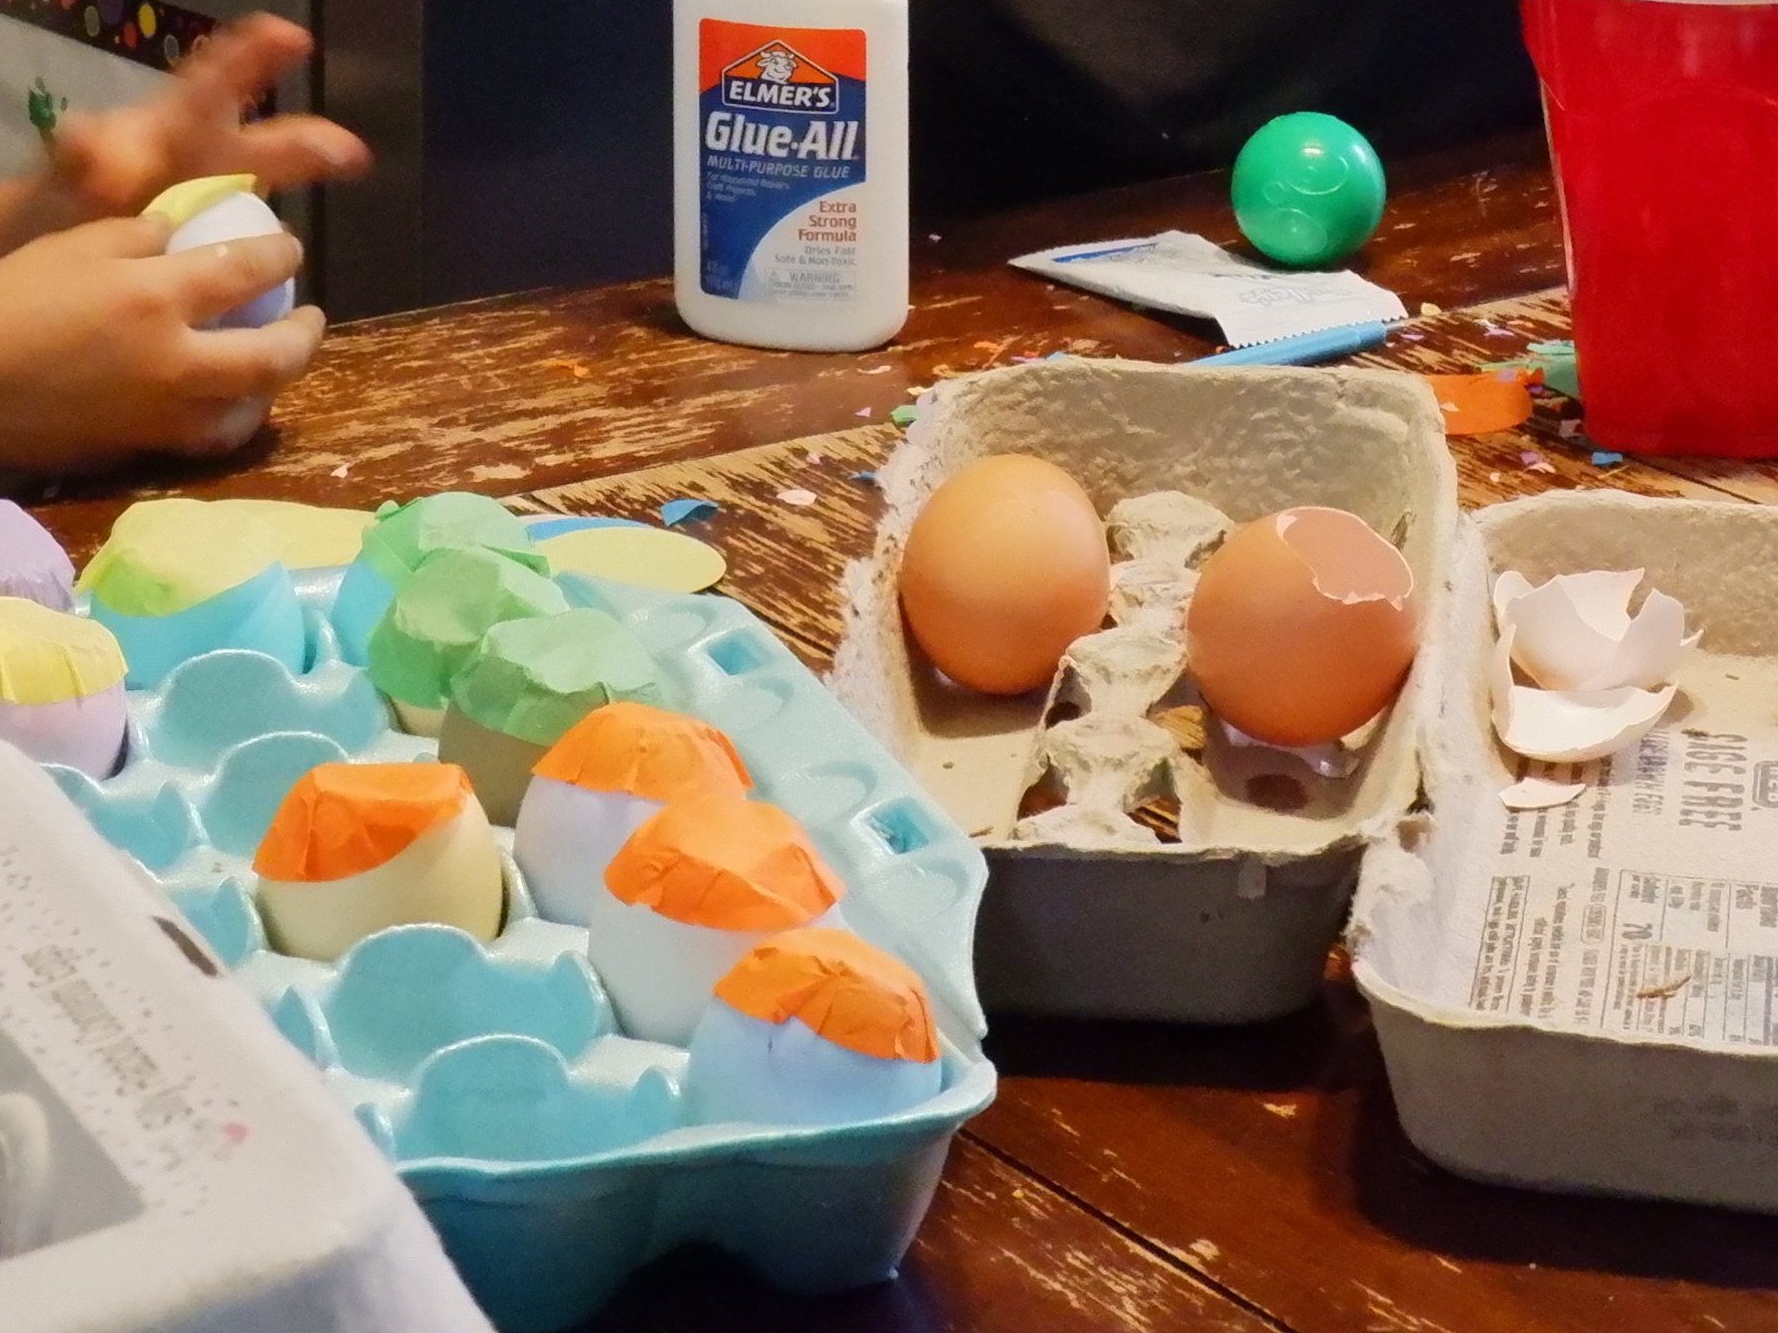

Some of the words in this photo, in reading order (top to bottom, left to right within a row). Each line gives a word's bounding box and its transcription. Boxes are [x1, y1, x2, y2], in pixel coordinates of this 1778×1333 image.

[729, 80, 832, 108] ELMER'S
[706, 155, 809, 178] MULTI-PURPOSE
[813, 166, 851, 179] GLUE
[819, 200, 856, 213] Extra
[809, 214, 857, 229] Strong
[798, 229, 856, 242] Formula
[1681, 729, 1749, 774] CAGE
[1678, 781, 1746, 831] FREE
